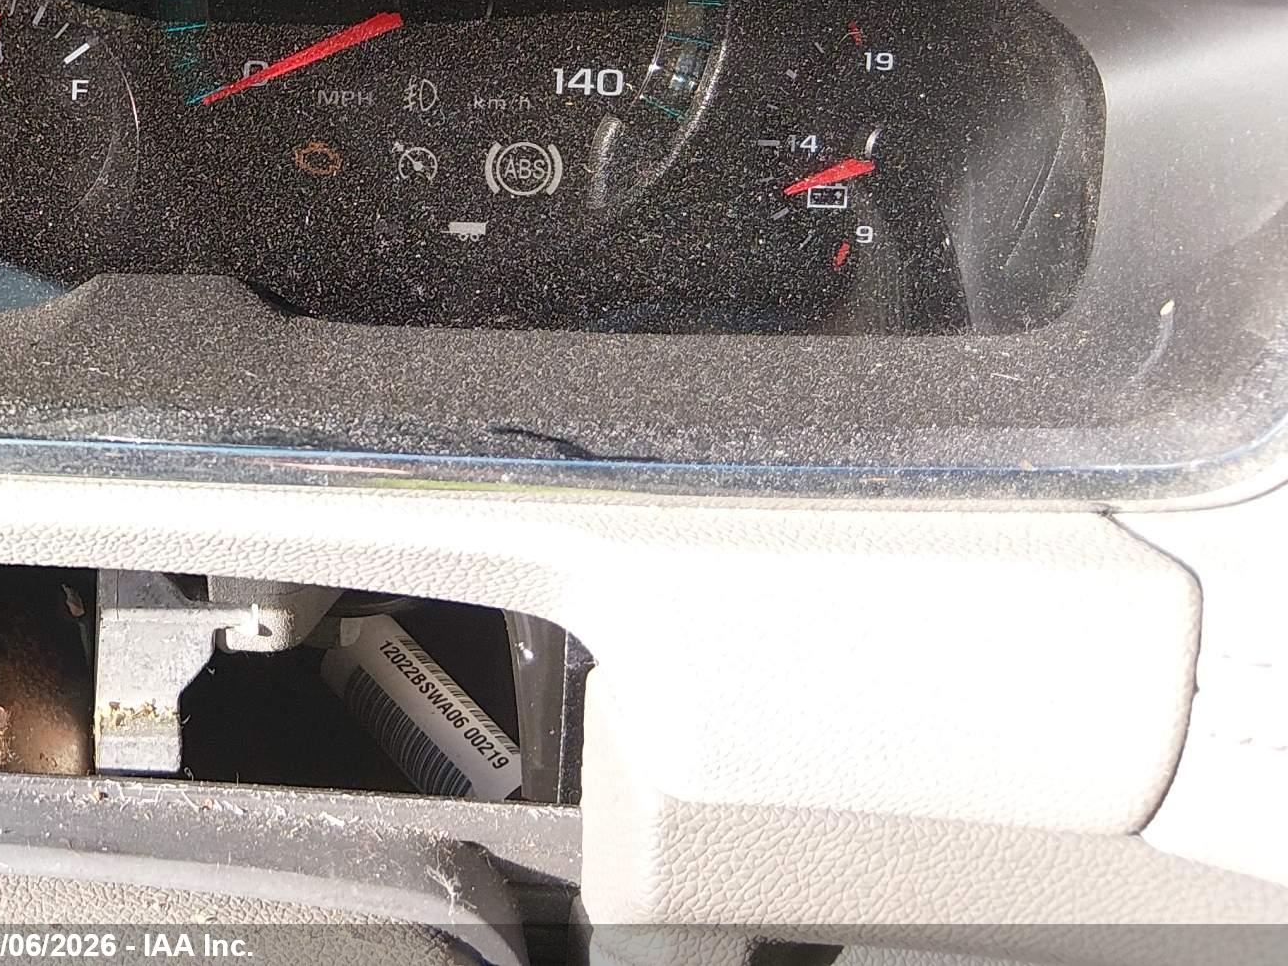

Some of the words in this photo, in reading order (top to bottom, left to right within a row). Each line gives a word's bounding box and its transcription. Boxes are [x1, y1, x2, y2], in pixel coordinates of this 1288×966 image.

[863, 51, 895, 72] 19
[72, 80, 88, 100] F
[553, 67, 624, 97] 140
[318, 90, 374, 106] MPH
[503, 156, 546, 181] ABS
[856, 226, 872, 243] 9
[379, 640, 468, 728] 12022BSWA06
[464, 727, 509, 768] 00219
